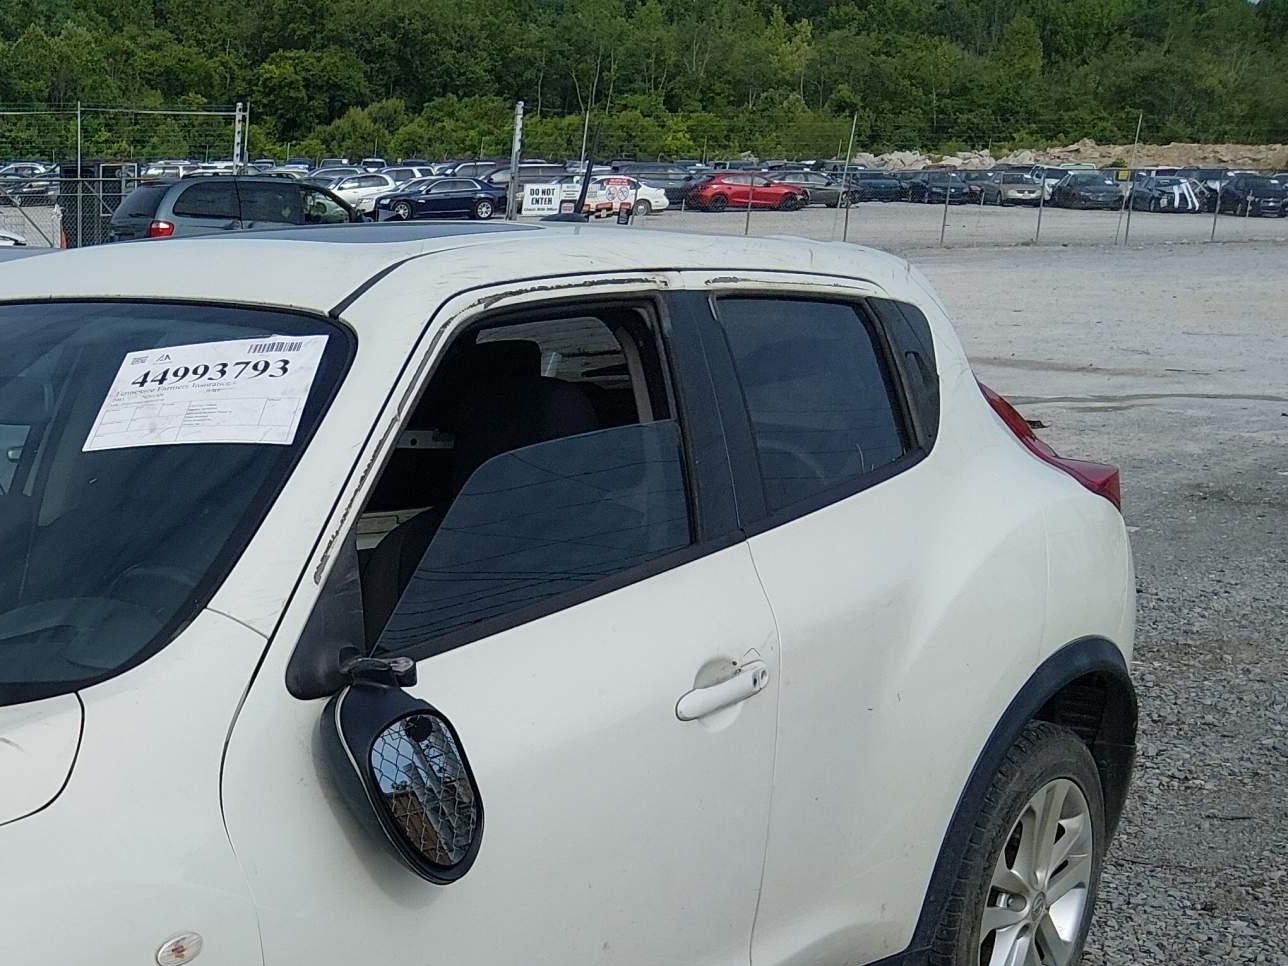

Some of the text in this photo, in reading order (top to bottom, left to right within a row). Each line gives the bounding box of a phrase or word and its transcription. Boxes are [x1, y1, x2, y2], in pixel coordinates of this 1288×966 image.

[541, 188, 555, 196] NOT
[531, 197, 553, 206] ENTER
[131, 358, 291, 388] 44993793
